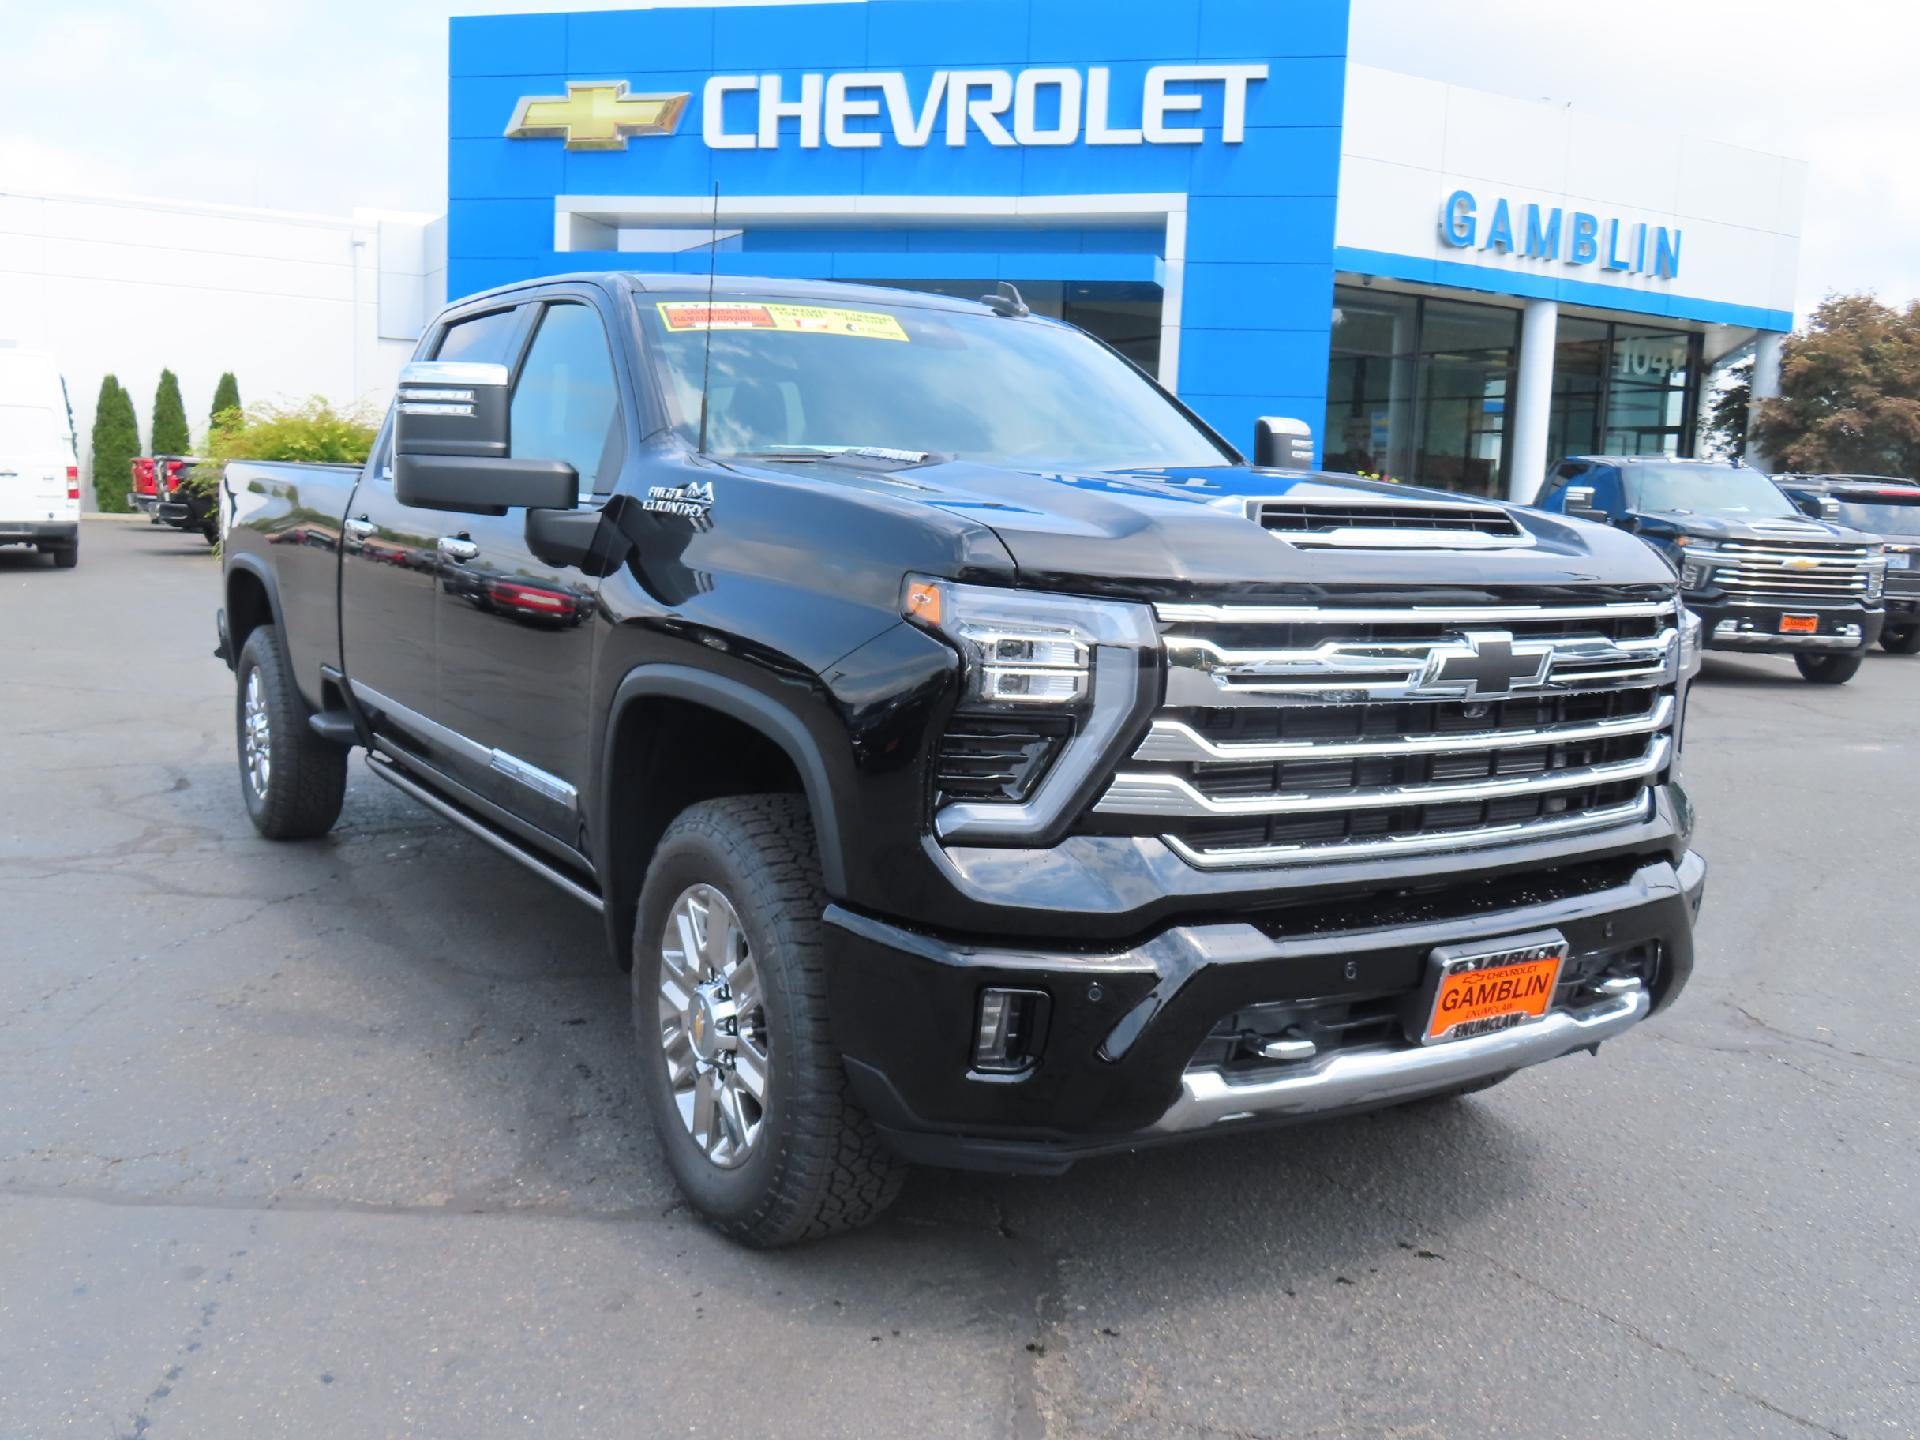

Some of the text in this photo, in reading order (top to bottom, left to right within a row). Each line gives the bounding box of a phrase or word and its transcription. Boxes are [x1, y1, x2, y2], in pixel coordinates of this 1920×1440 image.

[702, 64, 1268, 149] CHEVROLET
[1440, 190, 1682, 279] GAMBLIN
[1487, 965, 1537, 980] CHEVROLET
[1441, 973, 1550, 1012] GAMBLIN
[1453, 1011, 1523, 1038] ENUMCLAW
